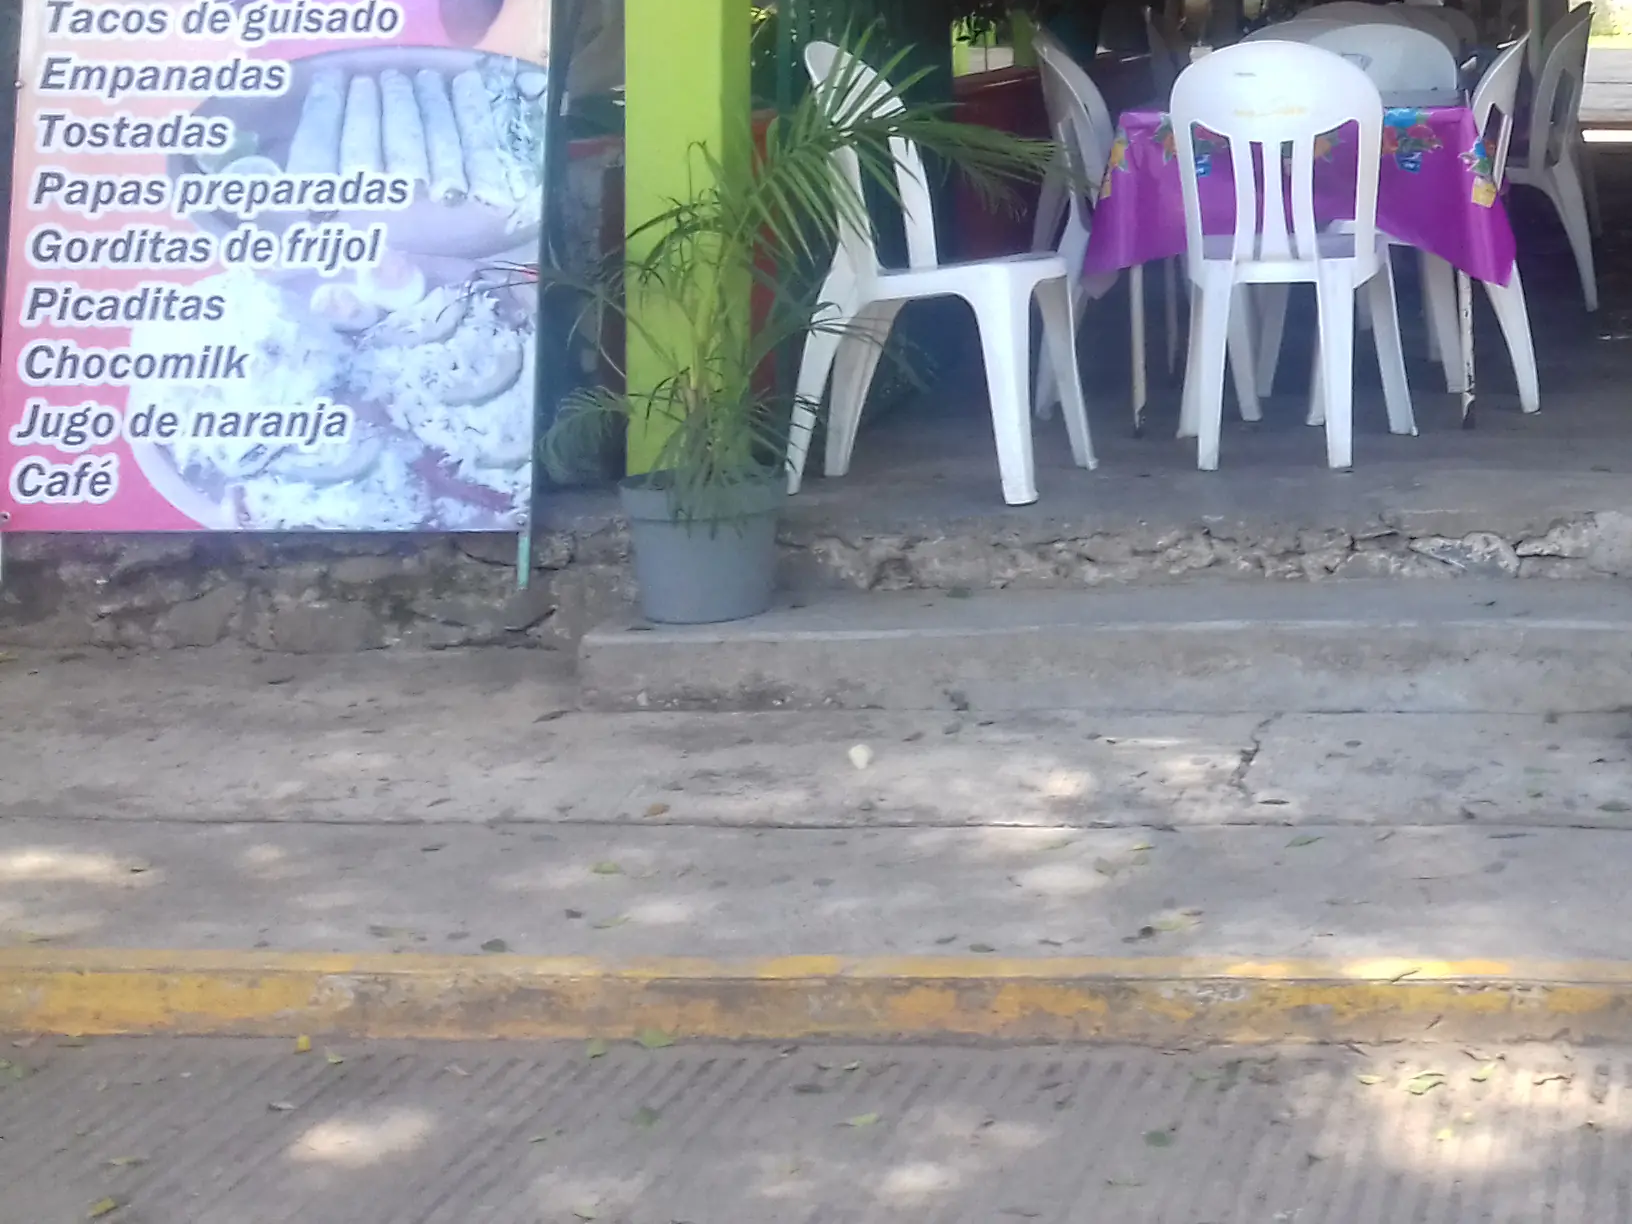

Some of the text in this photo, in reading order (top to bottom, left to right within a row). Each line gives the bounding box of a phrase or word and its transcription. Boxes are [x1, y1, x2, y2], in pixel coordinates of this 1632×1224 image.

[46, 0, 399, 40] Tacos de guisado
[39, 56, 286, 99] Empanadas
[37, 113, 228, 149] Tostadas
[33, 171, 408, 213] Papas preparadas
[31, 229, 381, 270] Gorditas de frijol
[26, 286, 226, 322] Picaditas
[24, 345, 249, 380] Chocomilk
[16, 404, 348, 445] Jugo de naranja
[15, 460, 113, 497] Café
